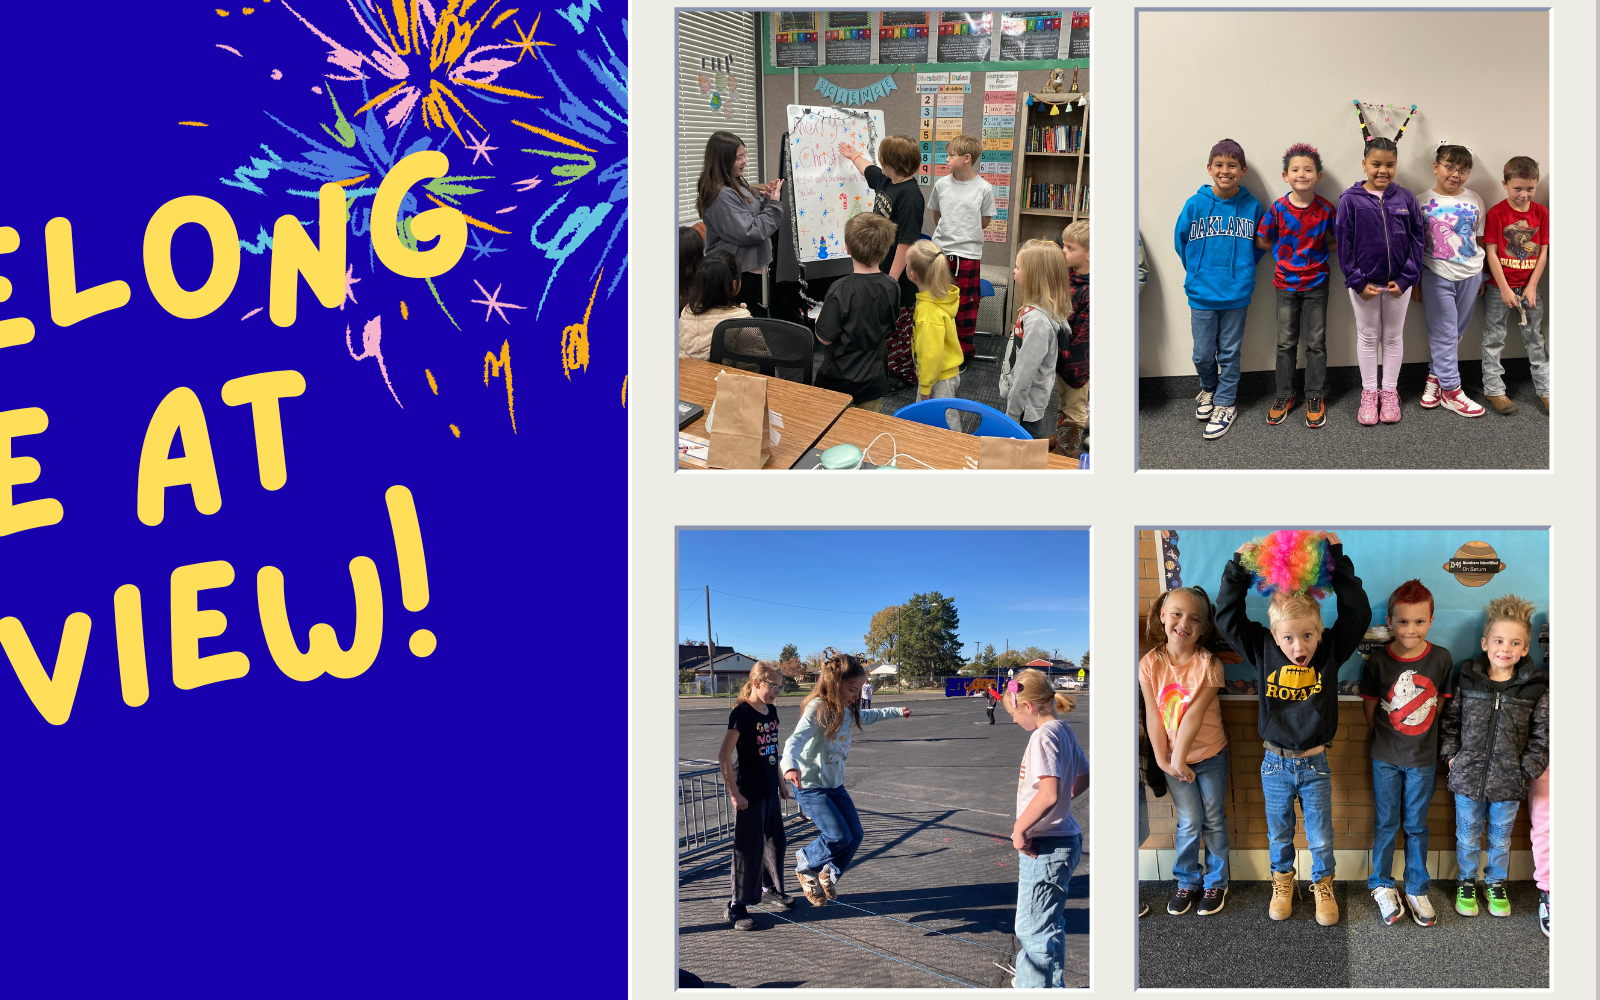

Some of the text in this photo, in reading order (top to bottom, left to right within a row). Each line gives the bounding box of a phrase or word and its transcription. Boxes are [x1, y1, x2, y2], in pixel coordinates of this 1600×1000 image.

[918, 73, 948, 82] Divisibility
[820, 78, 892, 100] SCIENCE
[924, 96, 930, 104] 2
[794, 117, 838, 144] Merry
[1189, 216, 1254, 241] OAKLAND
